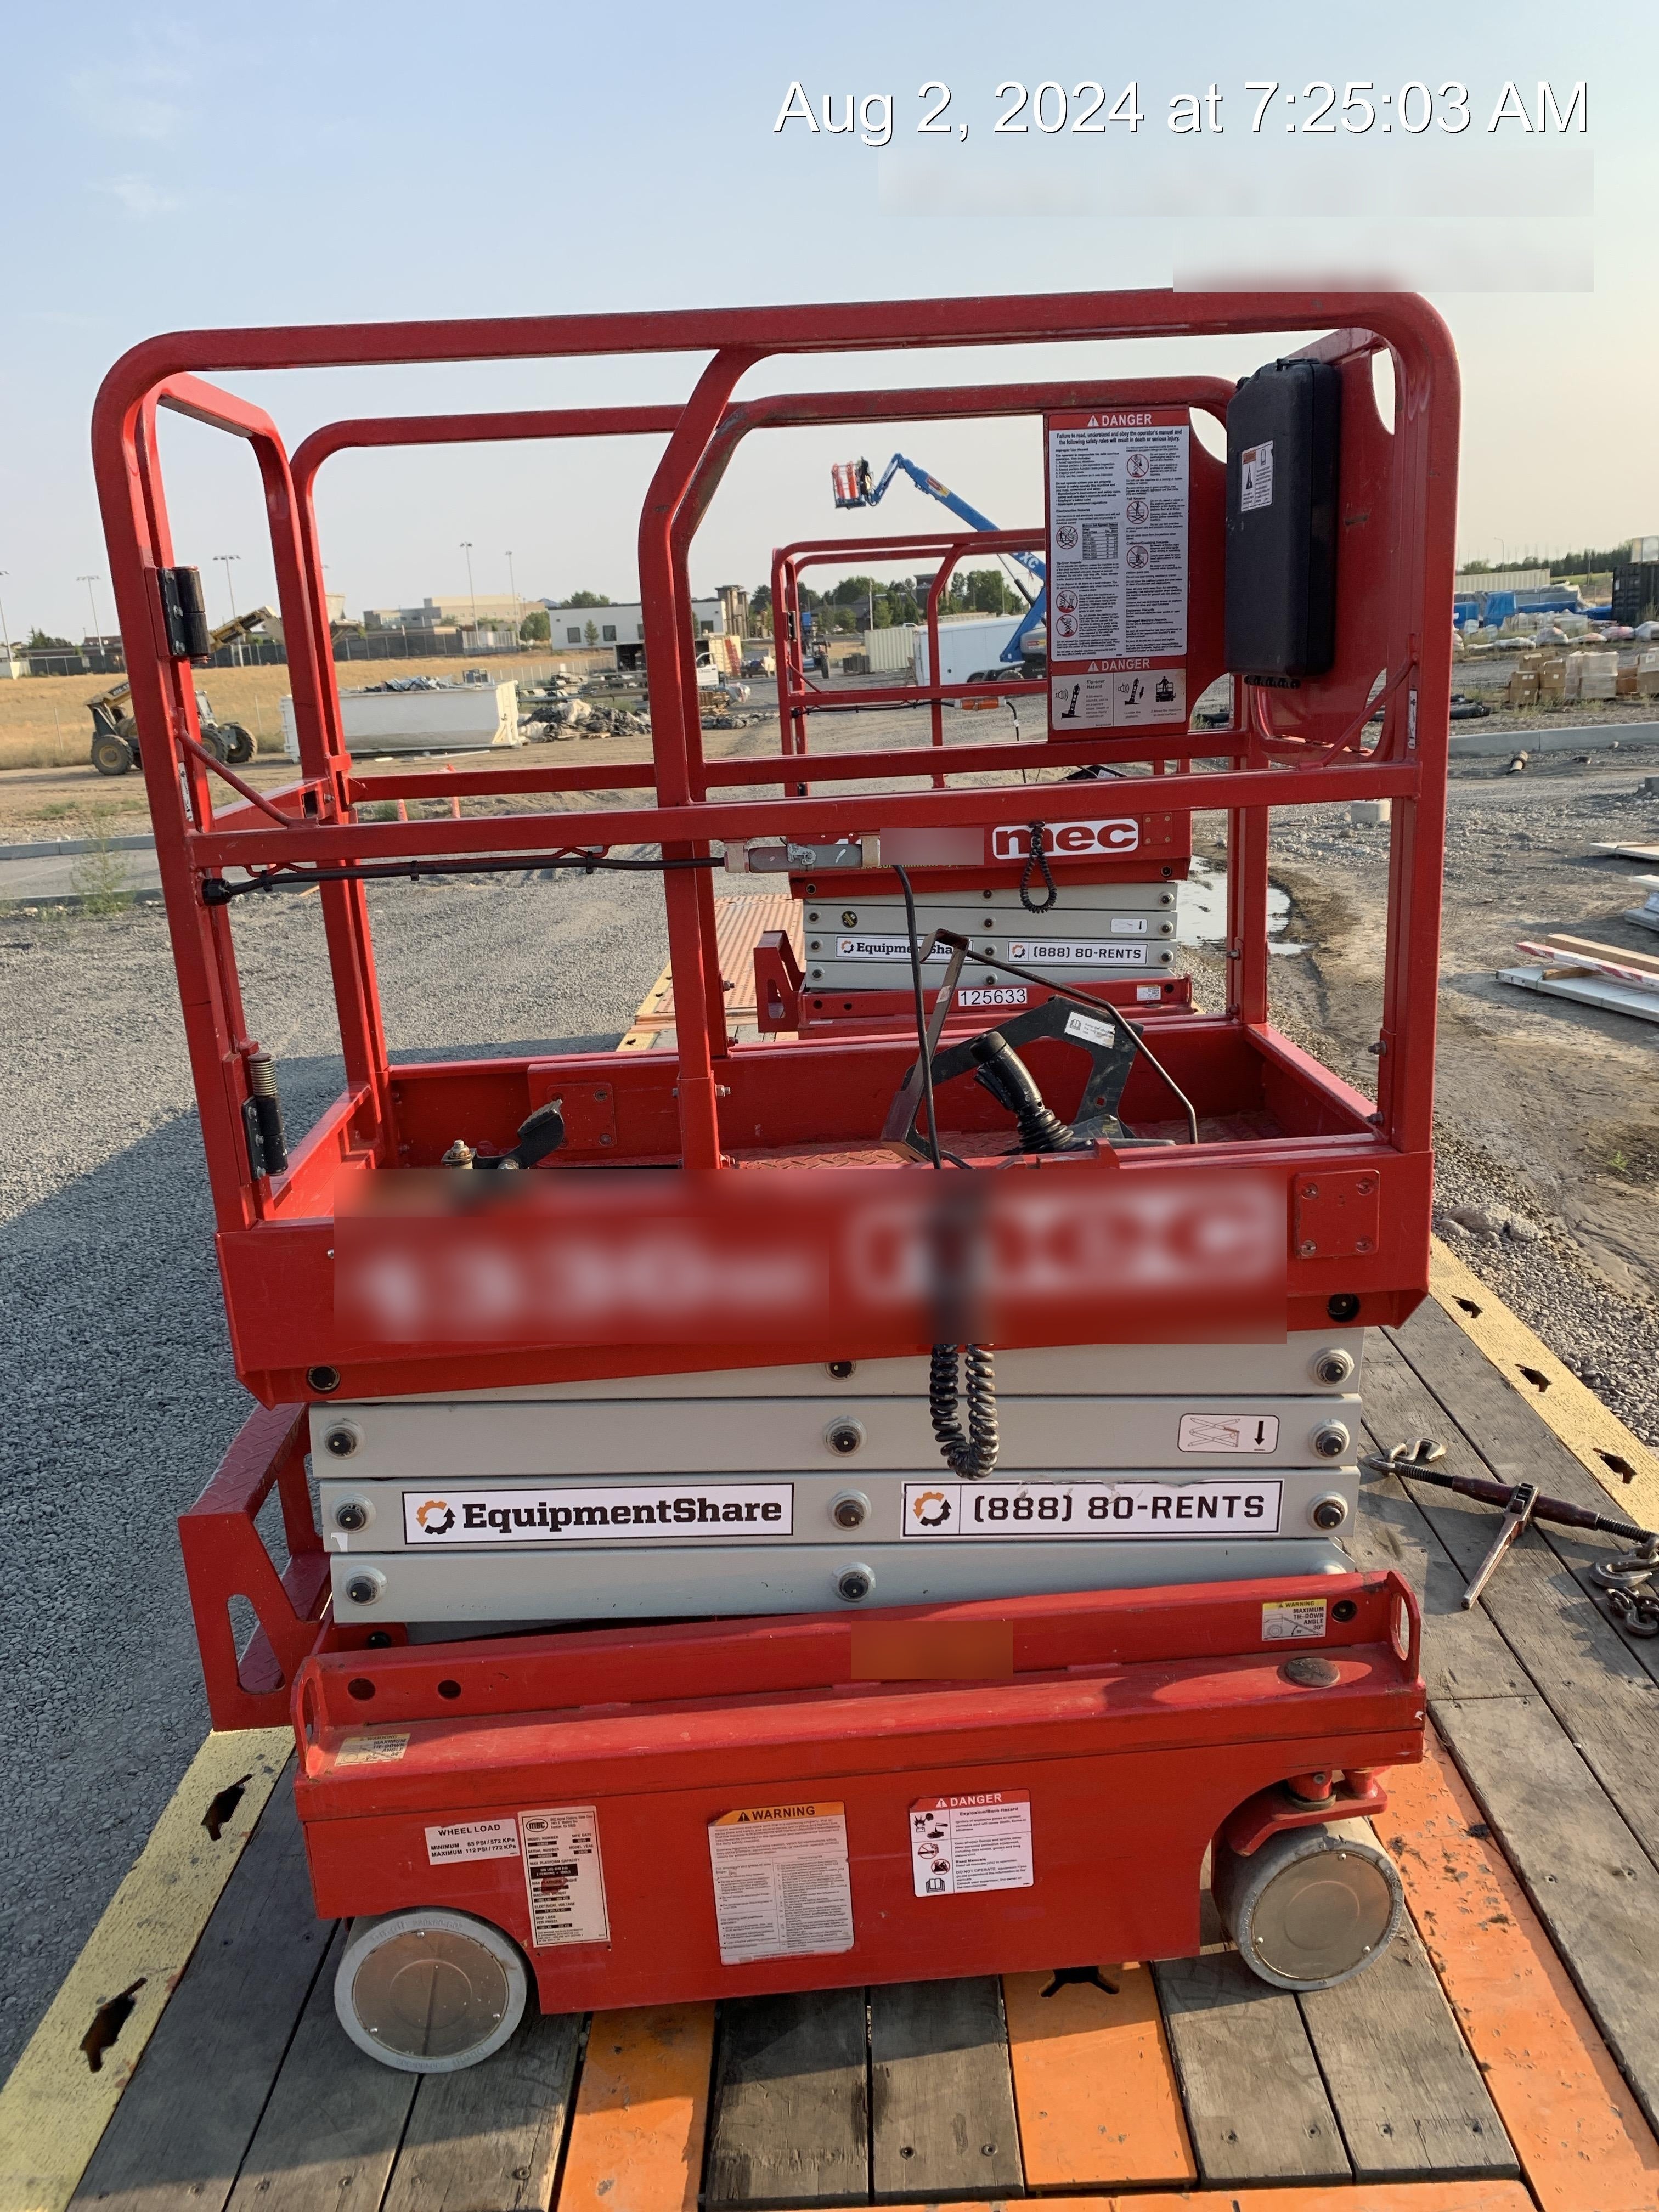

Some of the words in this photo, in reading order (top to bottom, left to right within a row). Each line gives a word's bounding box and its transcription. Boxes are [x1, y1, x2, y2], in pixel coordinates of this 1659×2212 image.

[1102, 413, 1152, 426] DANGER
[1102, 658, 1150, 671] DANGER
[996, 823, 1136, 855] mec
[1033, 946, 1070, 958] (888)
[1075, 948, 1141, 959] 80-RENTS
[960, 989, 1026, 1005] 125633
[462, 1498, 782, 1533] EquipmentShare
[974, 1495, 1073, 1522] (888)
[1088, 1495, 1265, 1519] 80-RENTS
[950, 1793, 1002, 1807] DANGER
[752, 1805, 816, 1820] WARNING
[438, 1827, 472, 1836] WHEEL
[475, 1824, 500, 1832] LOAD
